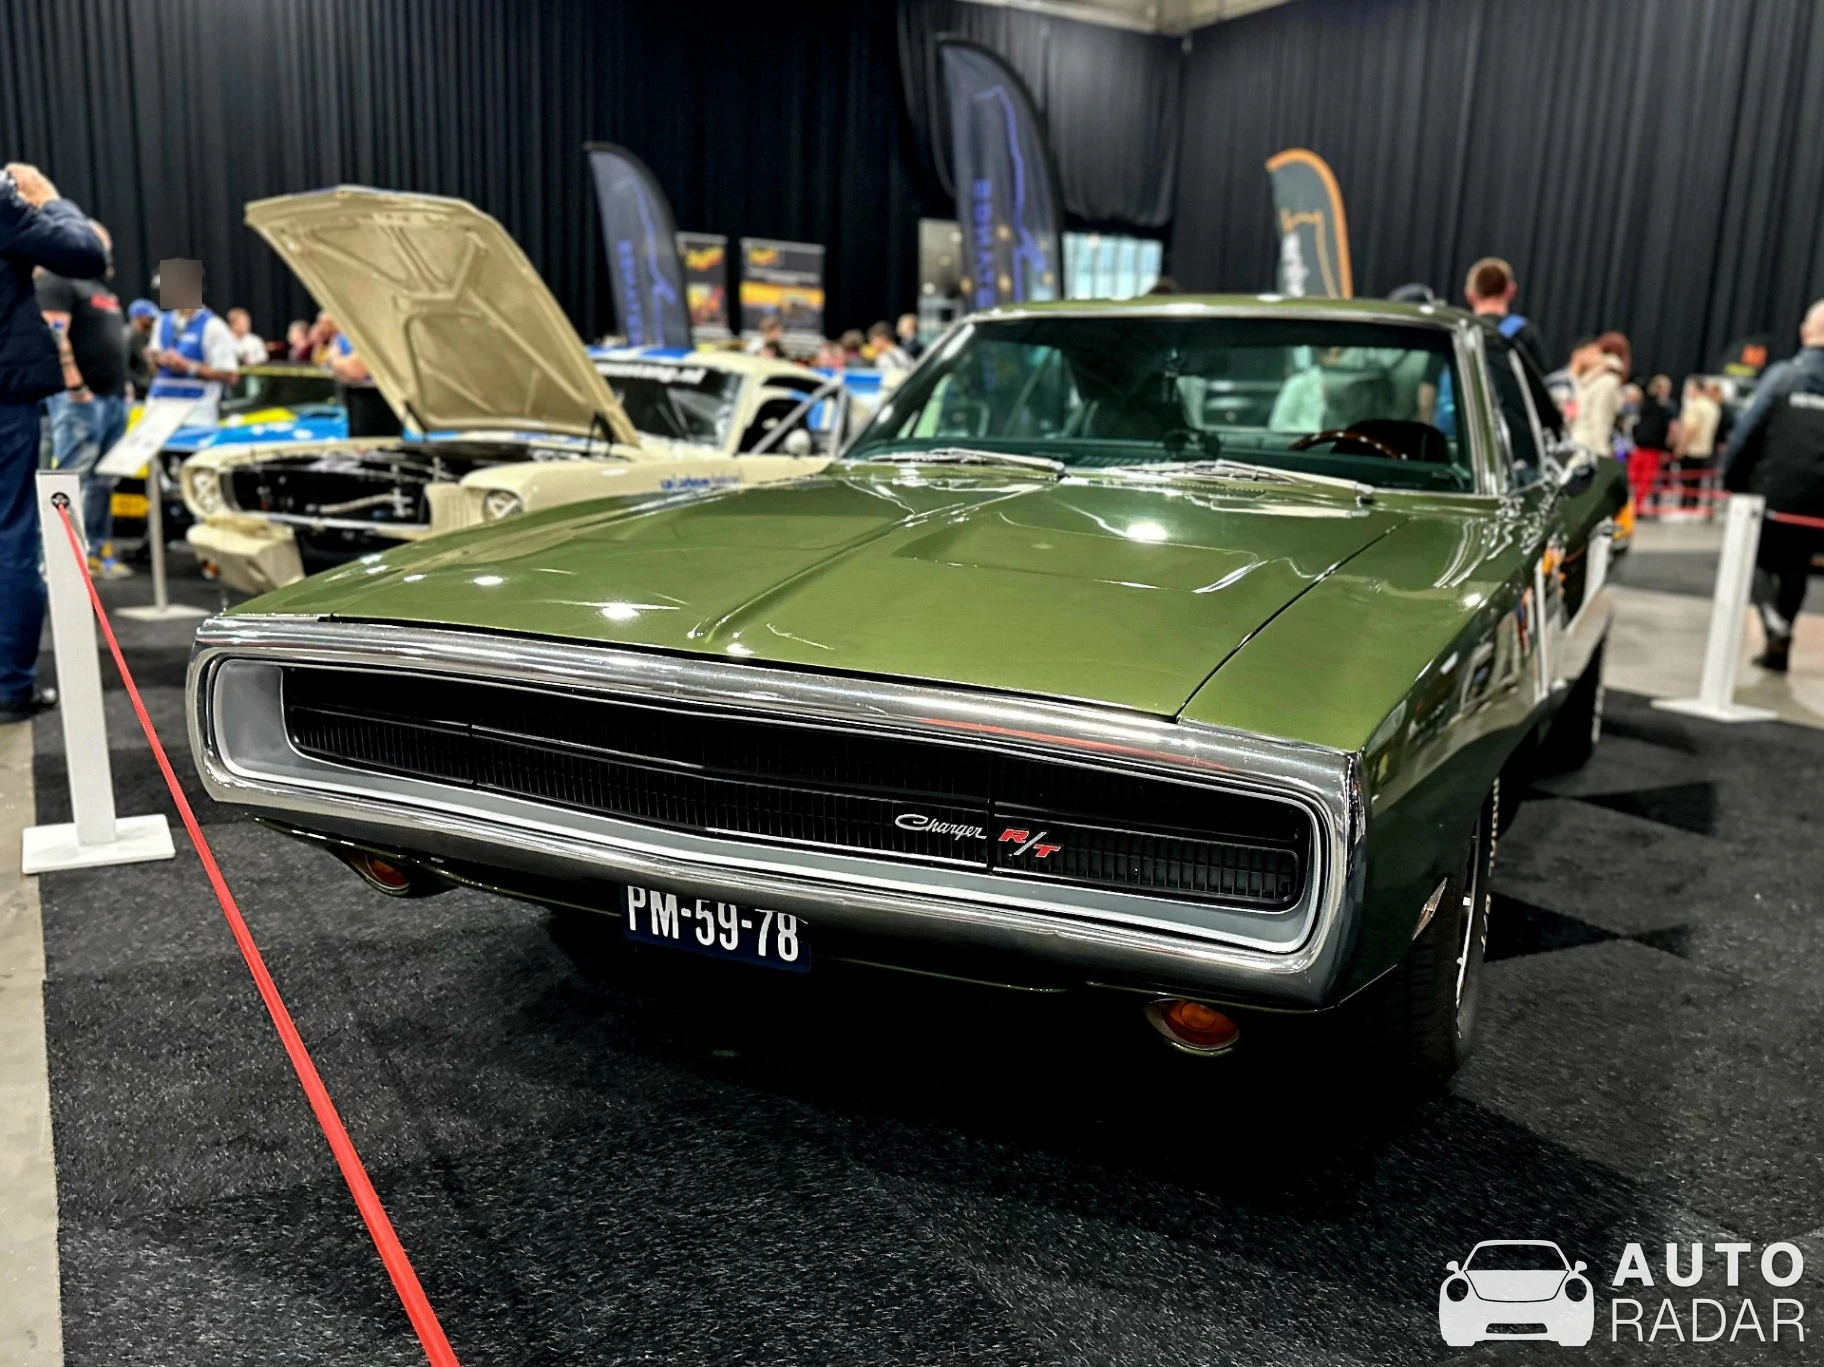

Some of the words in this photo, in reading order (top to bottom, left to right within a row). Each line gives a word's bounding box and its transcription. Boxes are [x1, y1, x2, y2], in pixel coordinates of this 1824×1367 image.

[894, 813, 988, 841] Charger
[998, 828, 1061, 858] R/T
[627, 884, 799, 962] PM-59-78
